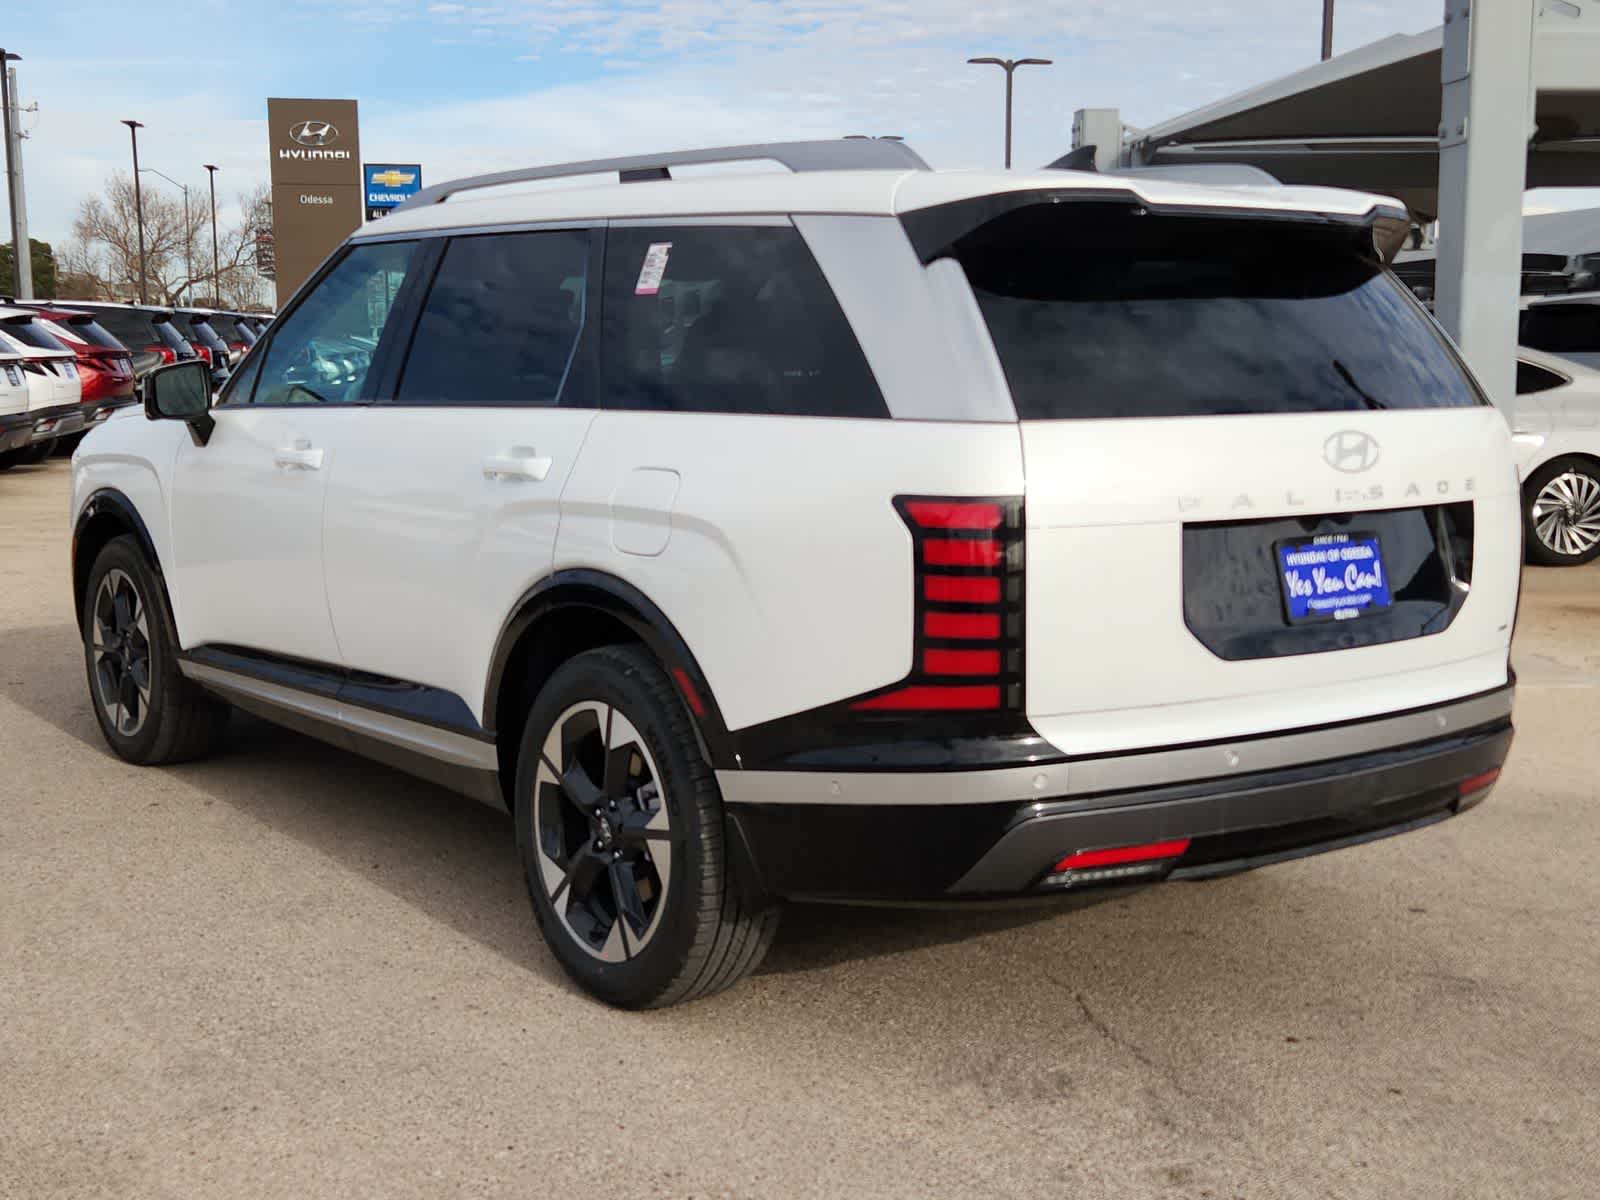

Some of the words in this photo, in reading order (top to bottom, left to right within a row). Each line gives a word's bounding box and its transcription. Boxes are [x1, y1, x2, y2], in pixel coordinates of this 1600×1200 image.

[279, 149, 350, 160] HYUNDAI
[299, 194, 334, 205] Odessa
[1178, 476, 1477, 513] PALISADE
[1285, 569, 1313, 598] Yes
[1312, 566, 1345, 595] You
